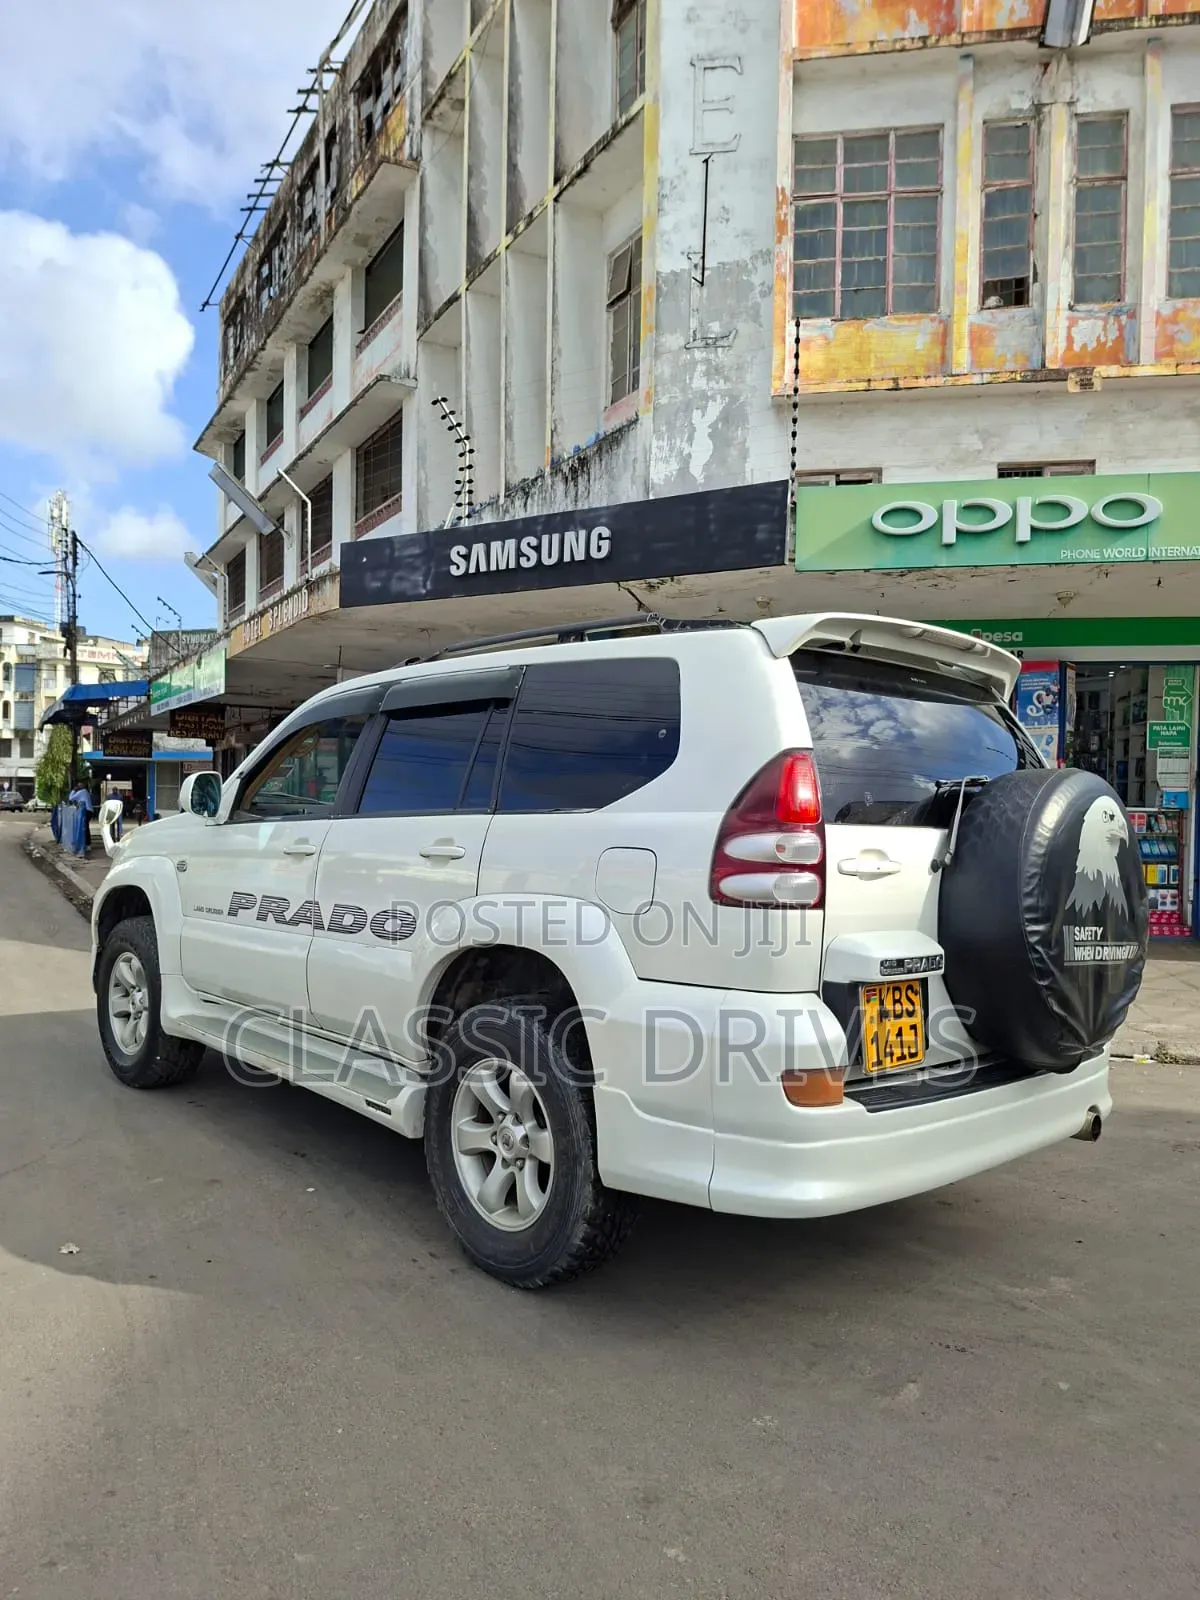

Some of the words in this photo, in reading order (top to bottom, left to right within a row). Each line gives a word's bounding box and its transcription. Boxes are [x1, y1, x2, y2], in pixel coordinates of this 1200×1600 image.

[449, 526, 612, 577] SAMSUNG
[1060, 549, 1101, 560] PHONE
[1103, 547, 1145, 558] WORLD
[268, 587, 309, 632] SPLENDID
[227, 891, 417, 941] PRADO
[1074, 926, 1104, 941] SAFETY
[1074, 946, 1095, 961] WHEN
[1095, 945, 1128, 961] DRIVING
[879, 983, 917, 1023] KBS
[870, 1023, 919, 1069] 141J
